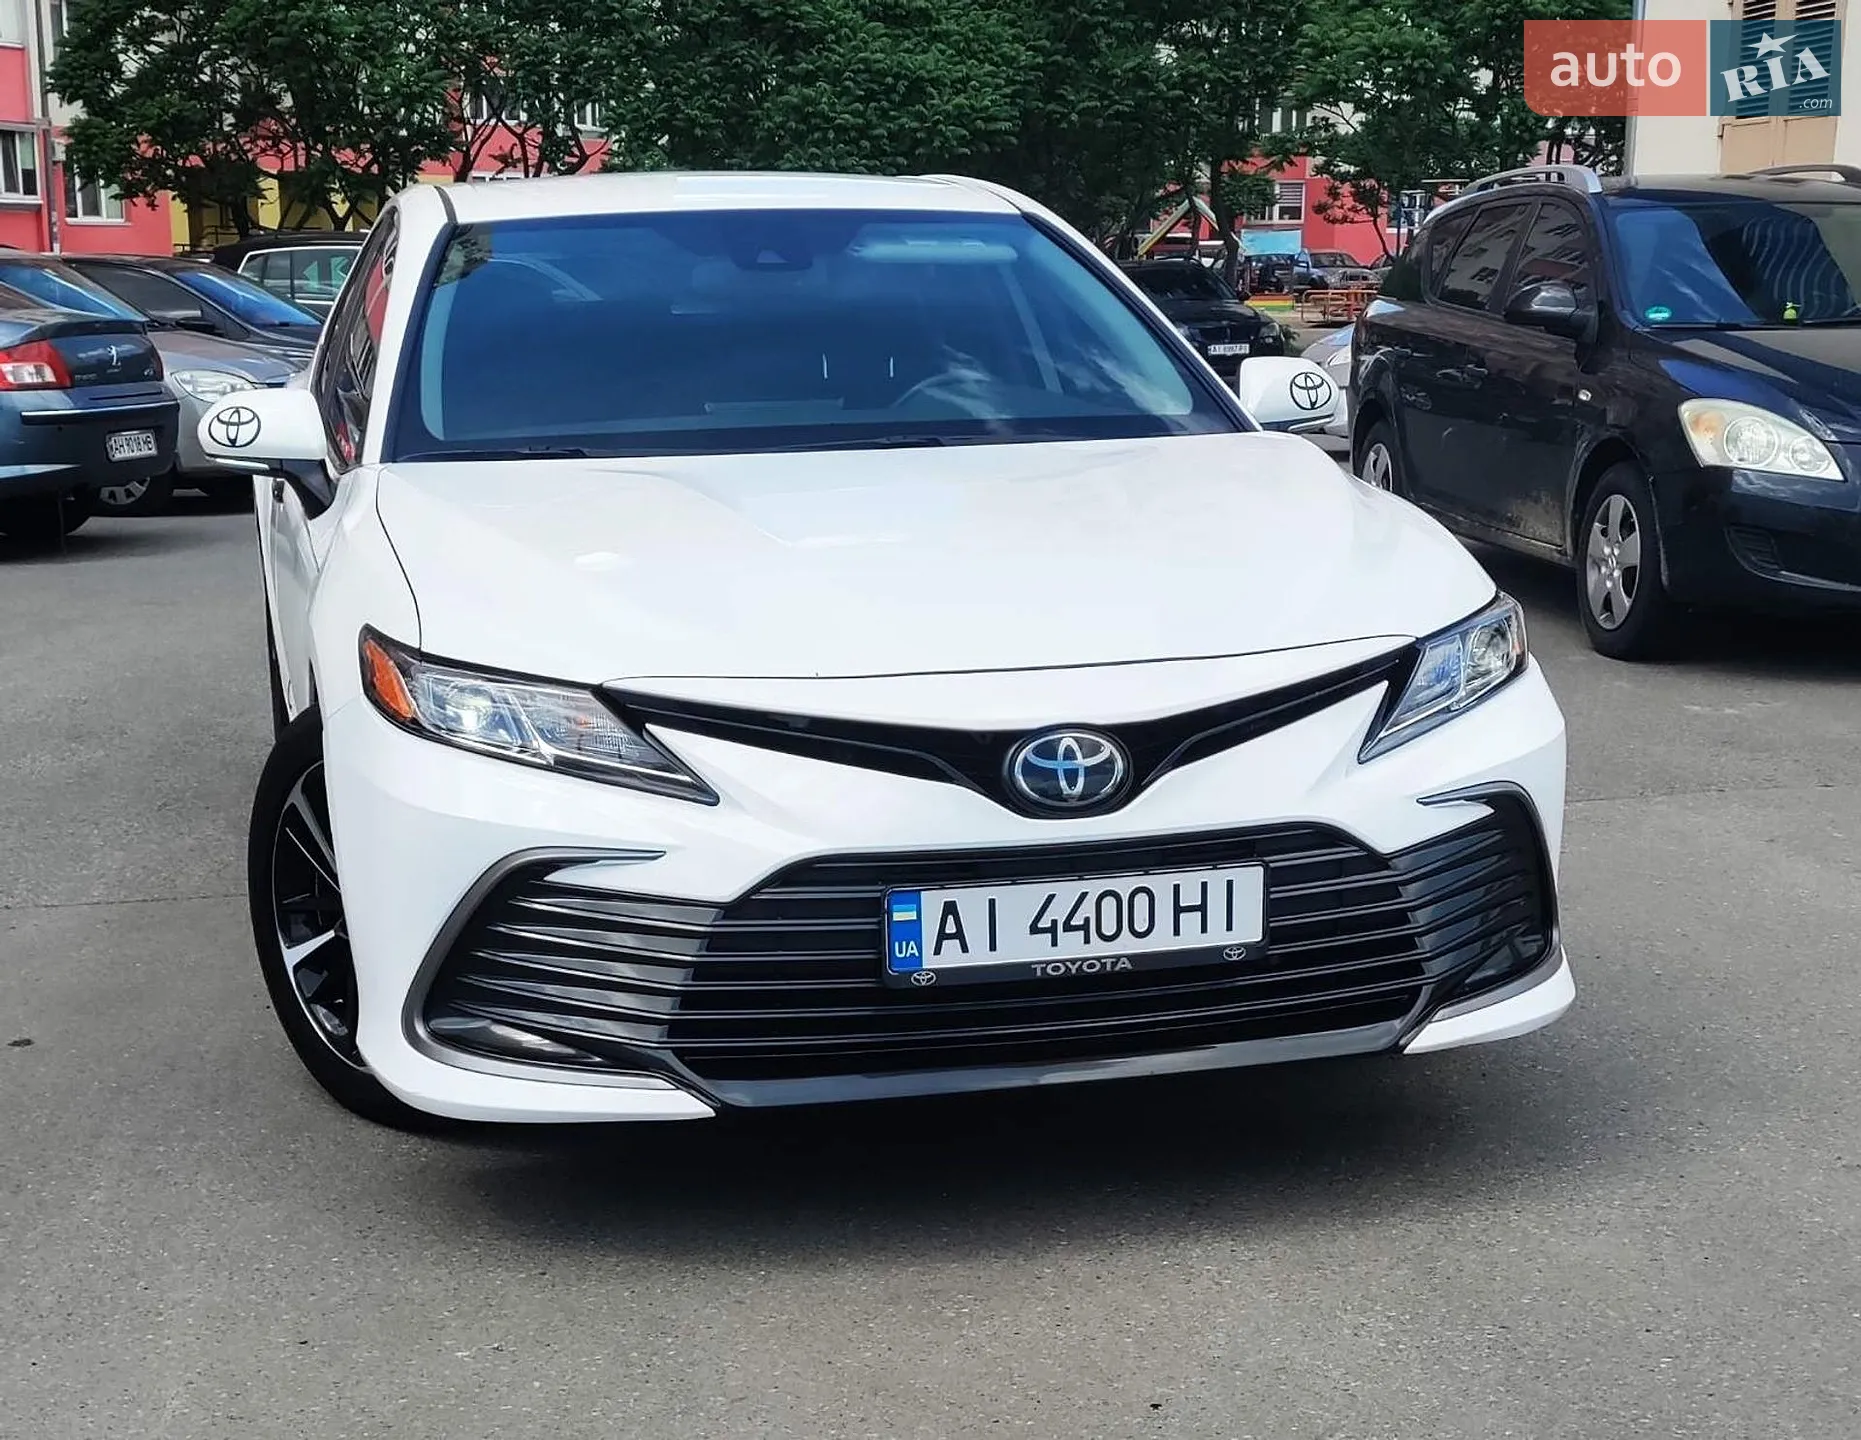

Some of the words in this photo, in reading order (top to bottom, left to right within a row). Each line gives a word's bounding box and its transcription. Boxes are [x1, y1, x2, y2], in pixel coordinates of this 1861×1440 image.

[933, 897, 997, 956] AI
[1029, 885, 1156, 948] 4400
[1173, 878, 1234, 937] HI
[895, 941, 919, 959] UA
[1031, 956, 1133, 978] TOYOTA
